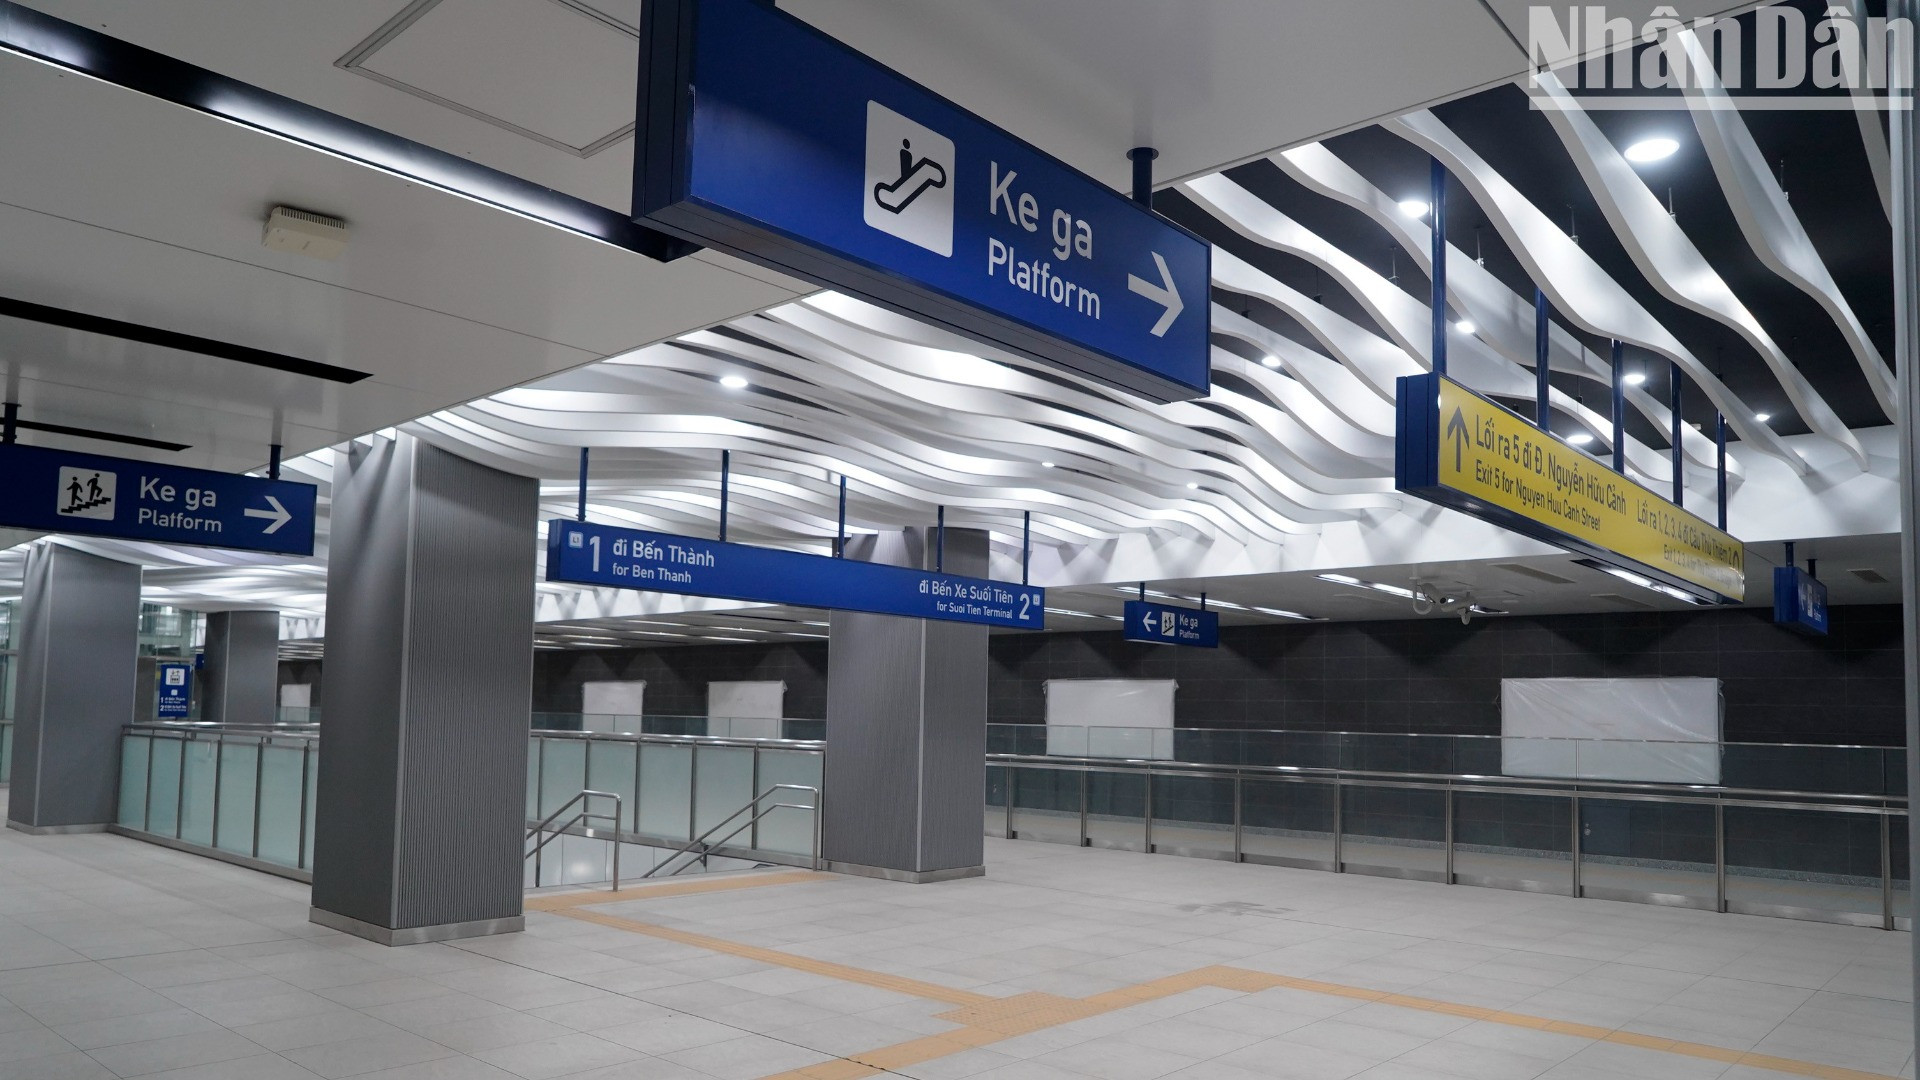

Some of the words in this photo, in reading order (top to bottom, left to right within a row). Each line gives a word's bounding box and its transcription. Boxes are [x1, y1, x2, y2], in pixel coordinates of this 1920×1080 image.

[989, 160, 1039, 233] Ke
[1052, 208, 1093, 261] ga
[988, 237, 1101, 320] Platform
[1476, 414, 1495, 453] Lối
[1498, 436, 1510, 460] ra
[1513, 434, 1520, 464] 5
[1522, 440, 1532, 471] đi
[1535, 445, 1545, 477] Đ.
[1548, 453, 1584, 496] Nguyễn
[1586, 471, 1605, 506] Hữu
[1606, 483, 1626, 516] Cảnh
[140, 476, 176, 502] Ke
[185, 487, 217, 511] ga
[1476, 459, 1492, 486] Exit
[1494, 467, 1500, 489] 5
[1502, 472, 1514, 494] for
[1516, 478, 1545, 509] Nguyen
[1547, 492, 1562, 516] Huu
[1563, 499, 1580, 523] Canh
[1581, 506, 1601, 532] Street
[138, 507, 222, 533] Platform
[1637, 499, 1648, 526] Lối
[1650, 511, 1656, 530] ra
[590, 535, 600, 573] 1
[613, 539, 627, 557] đi
[632, 539, 663, 561] Bến
[668, 544, 715, 568] Thành
[613, 562, 629, 577] for
[632, 564, 655, 579] Ben
[658, 567, 692, 584] Thanh
[919, 580, 928, 594] đi
[932, 579, 952, 597] Bến
[955, 583, 967, 599] Xe
[969, 585, 991, 602] Suối
[993, 588, 1013, 604] Tiên
[1019, 593, 1030, 620] 2
[937, 600, 947, 612] for
[949, 602, 965, 614] Suoi
[967, 603, 981, 615] Tien
[983, 606, 1013, 619] Terminal
[1180, 614, 1188, 626] Ke
[1190, 618, 1198, 629] ga
[1180, 630, 1199, 639] Platform
